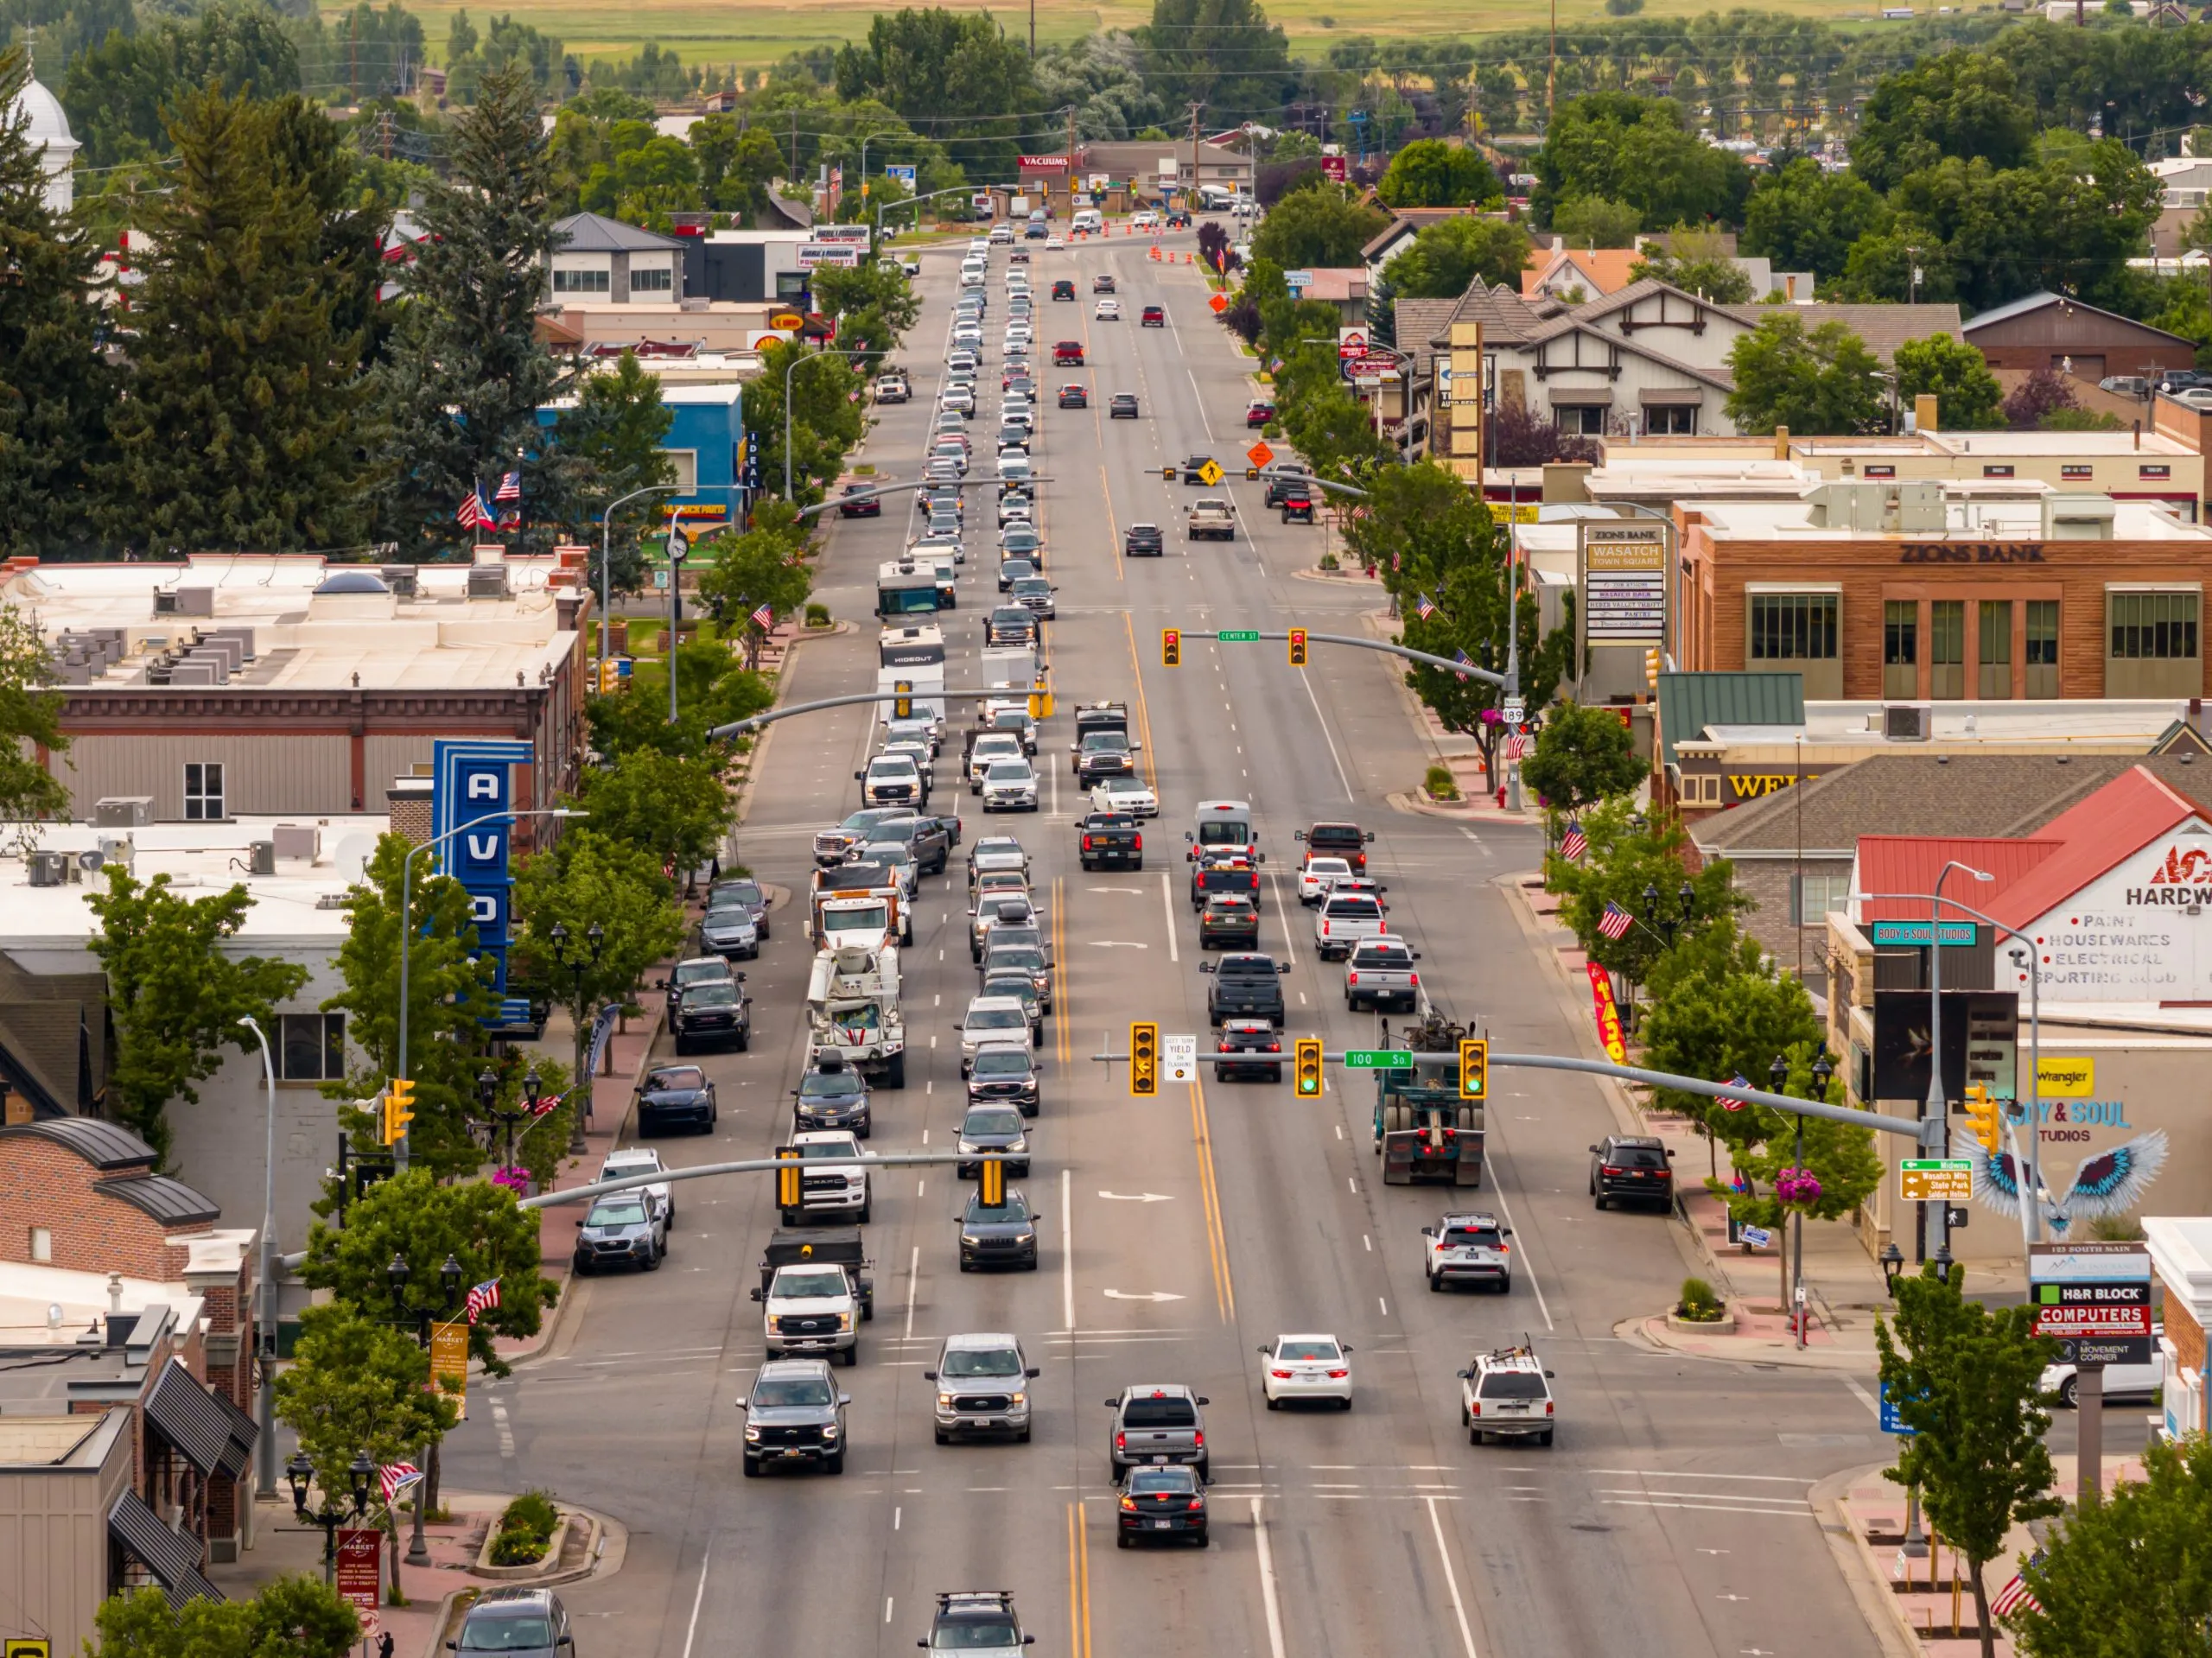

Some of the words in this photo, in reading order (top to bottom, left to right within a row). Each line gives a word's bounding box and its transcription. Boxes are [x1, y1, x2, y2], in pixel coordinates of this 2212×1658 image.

[1024, 157, 1068, 166] VACUUMS
[702, 505, 726, 514] PARTS
[1595, 530, 1625, 539] ZIONS
[1627, 530, 1656, 539] BANK
[1593, 546, 1659, 556] WASATCH
[1900, 544, 1971, 562] ZIONS
[1977, 544, 2046, 562] BANK
[1504, 711, 1522, 721] 189
[2083, 916, 2135, 927] PAINT
[1878, 929, 1901, 939] BODY
[1904, 930, 1909, 939] &
[1911, 930, 1933, 939] SOUL
[2050, 934, 2171, 946] HOUSEWARES
[2056, 953, 2163, 965] ELECTRICAL
[1353, 1054, 1372, 1064] 100
[1392, 1054, 1407, 1064] So.
[2037, 1071, 2088, 1086] Wrangler
[2055, 1102, 2067, 1121] &
[2071, 1102, 2132, 1128] SOUL
[2038, 1130, 2091, 1141] TUDIOS
[2063, 1288, 2092, 1299] H&R
[2094, 1288, 2140, 1299] BLOCK
[2040, 1308, 2142, 1322] COMPUTERS
